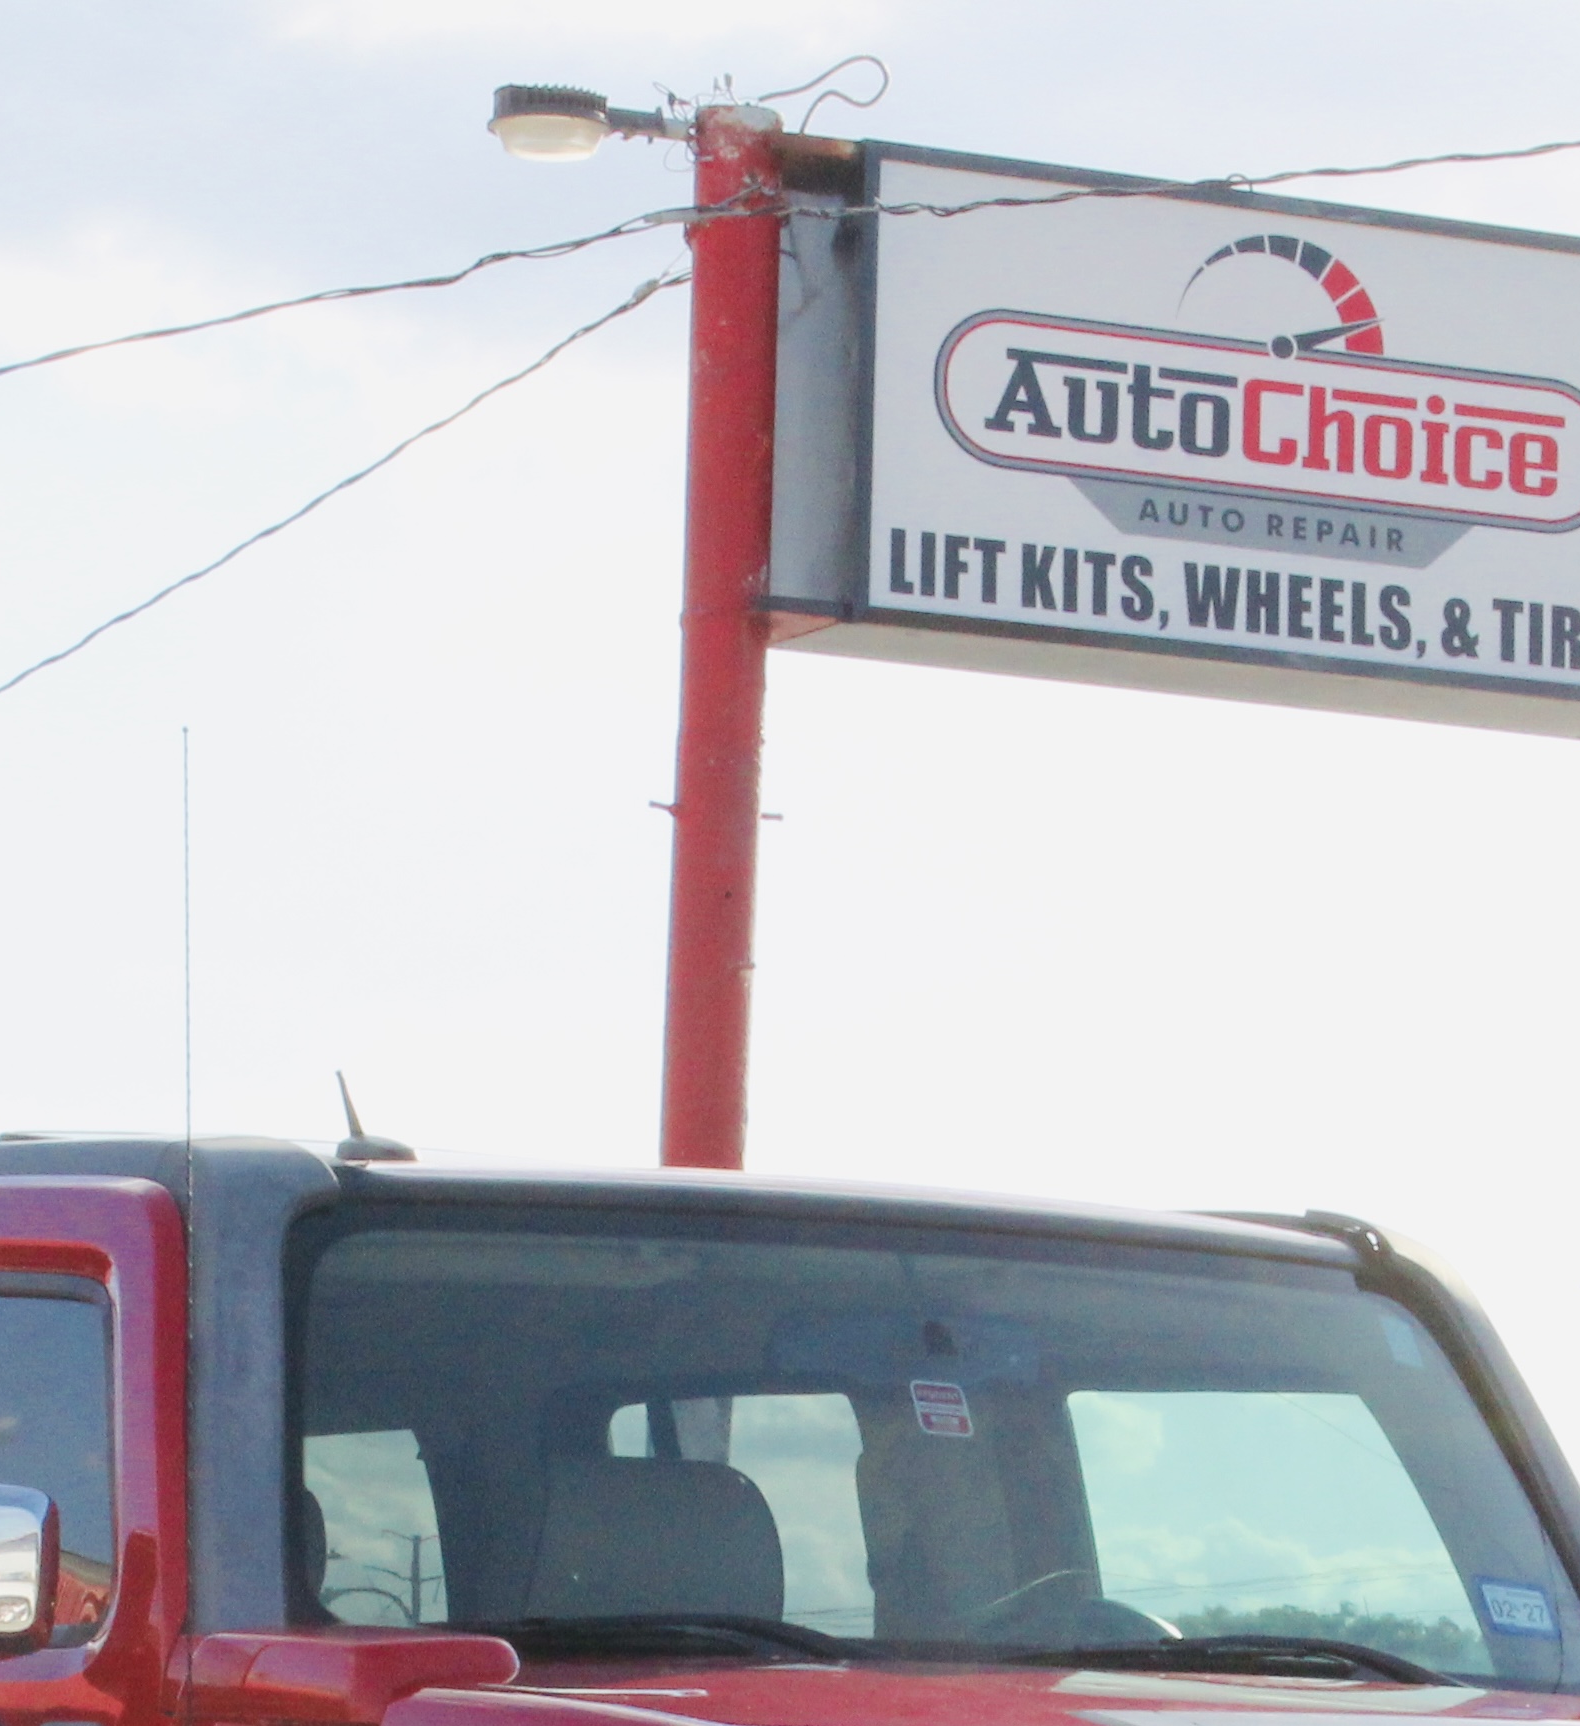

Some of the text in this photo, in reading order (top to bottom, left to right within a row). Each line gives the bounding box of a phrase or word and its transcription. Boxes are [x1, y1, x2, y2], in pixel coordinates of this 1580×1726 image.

[1139, 499, 1406, 552] AUTO REPAIR
[890, 528, 1005, 604] LIFT
[1022, 544, 1169, 631] KITS,
[1183, 562, 1426, 660] WHEELS,
[1441, 598, 1479, 658] &
